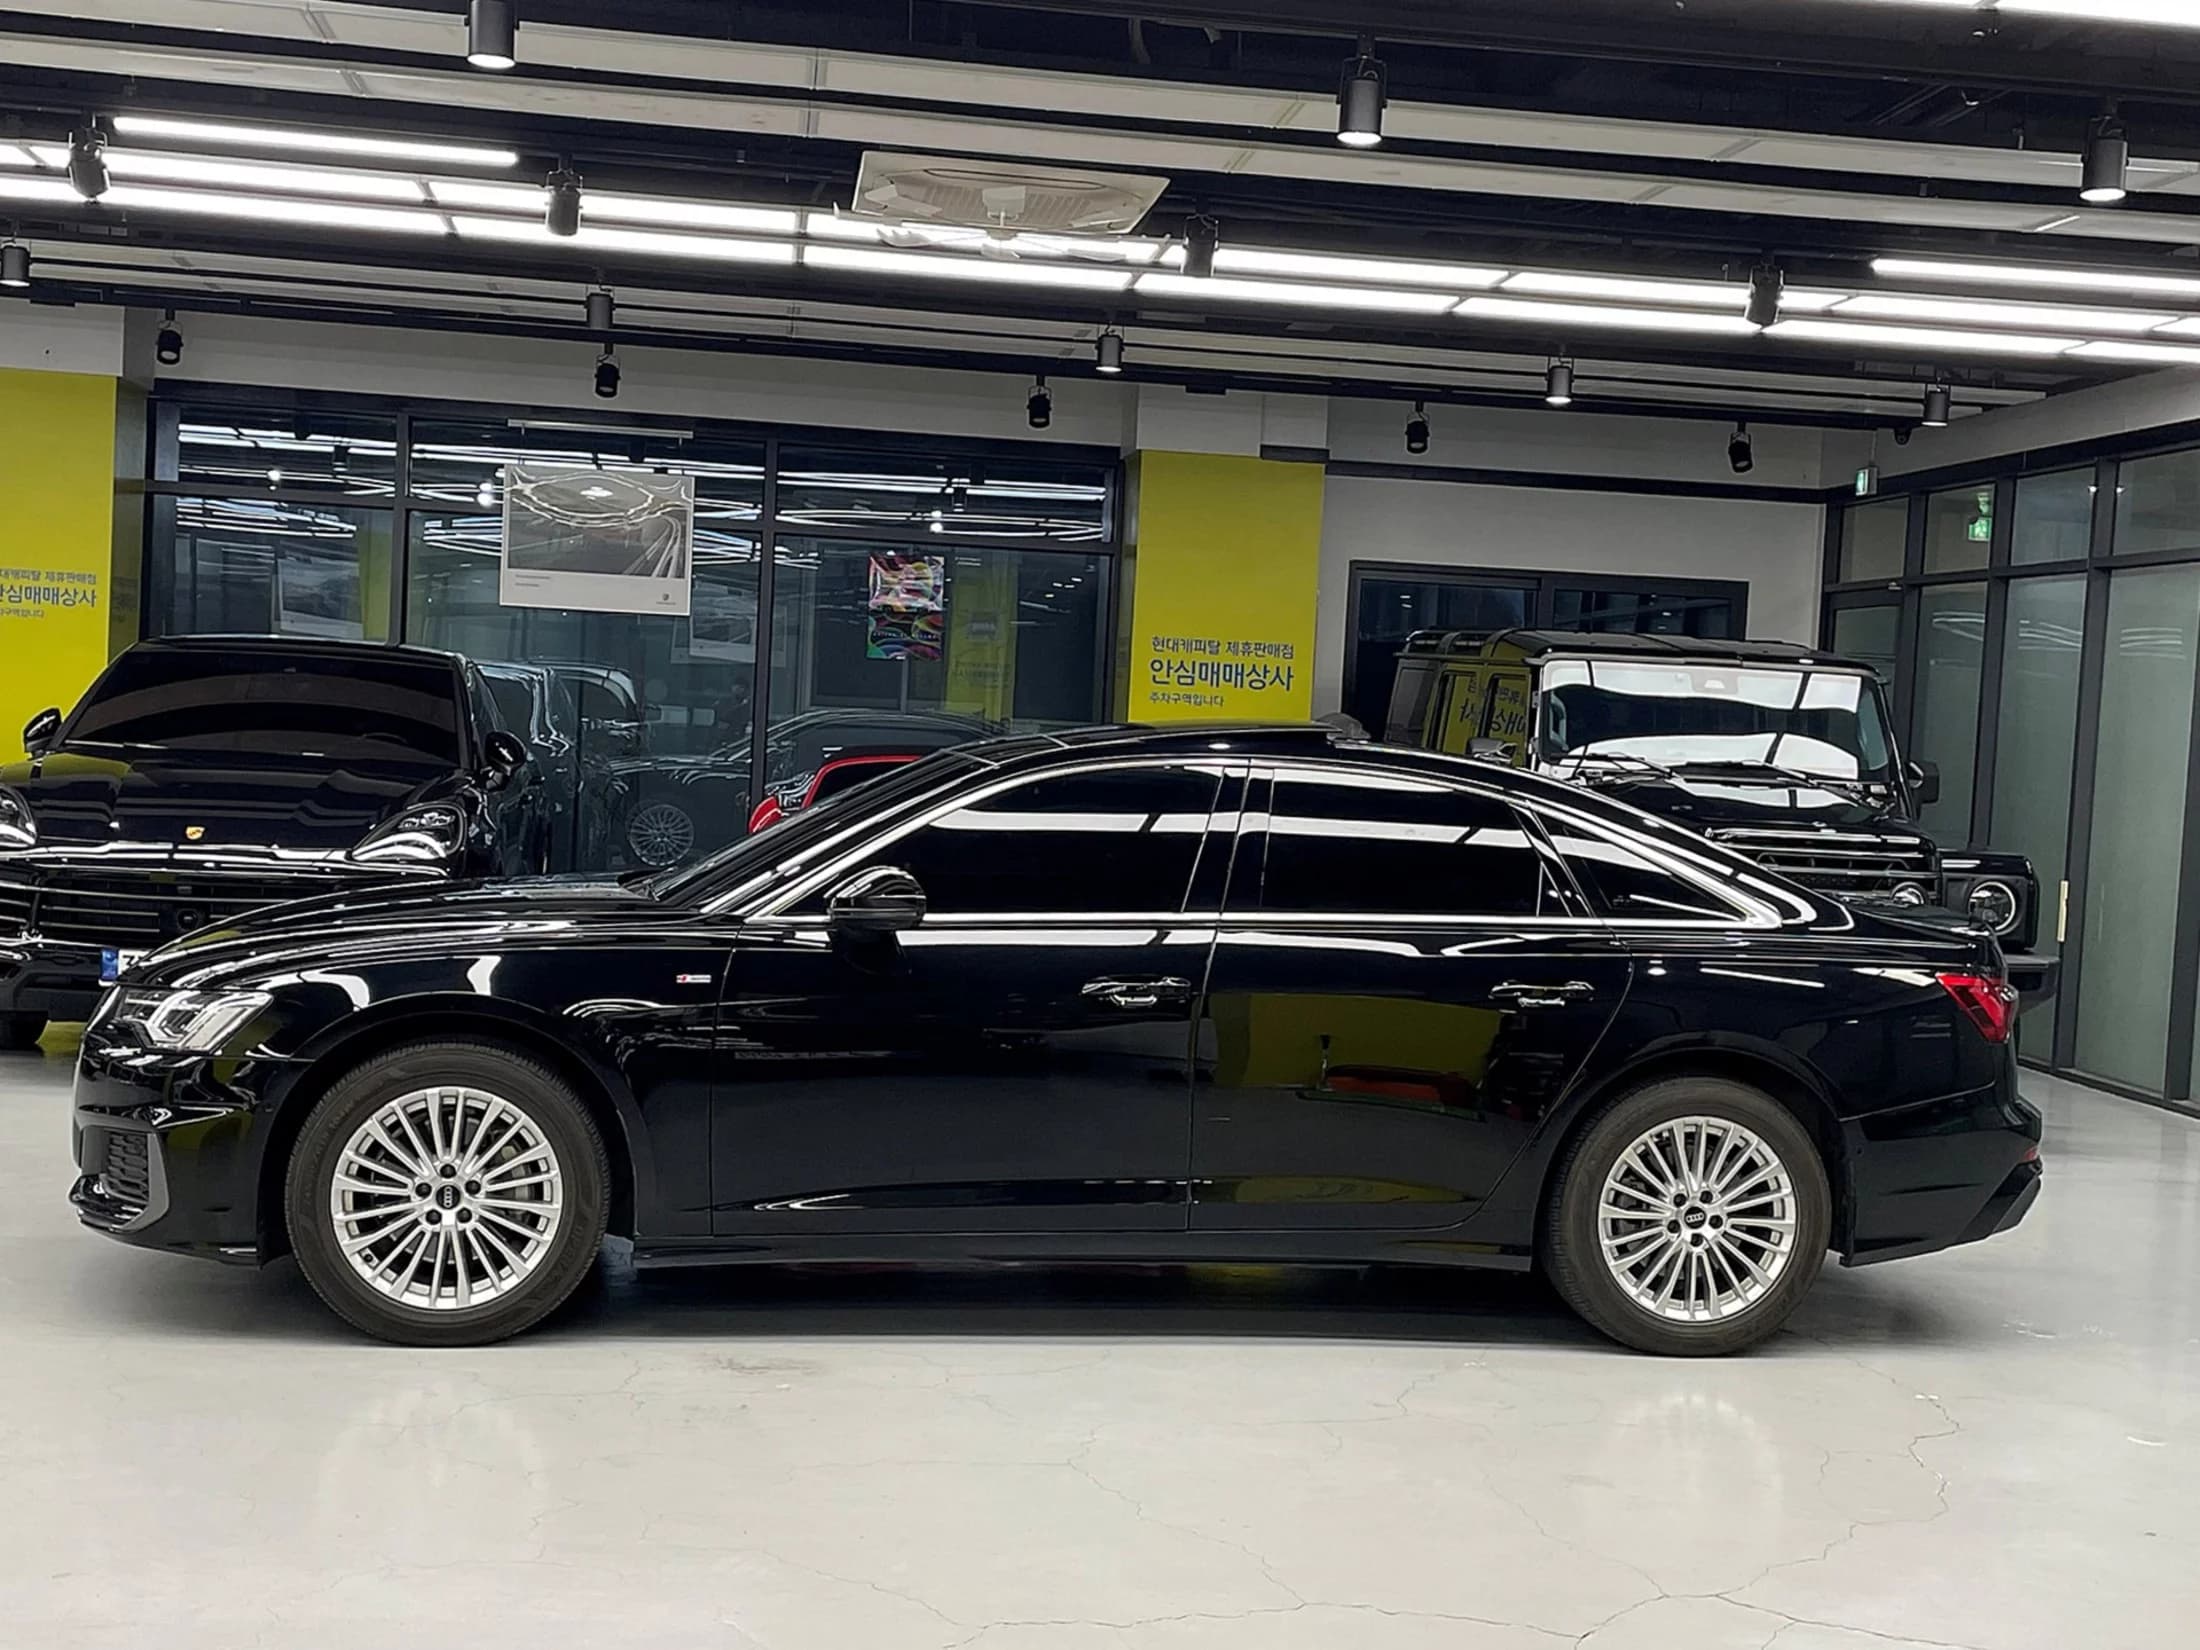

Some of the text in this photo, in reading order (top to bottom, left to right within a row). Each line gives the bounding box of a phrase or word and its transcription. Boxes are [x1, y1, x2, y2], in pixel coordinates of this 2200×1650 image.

[0, 569, 41, 581] 대캐피탈
[0, 583, 96, 608] 심매매상사
[1152, 636, 1294, 659] 현대캐피탈 제휴판매점
[1150, 659, 1294, 691] 안심매매상사
[1150, 692, 1224, 707] 주차구역입니다
